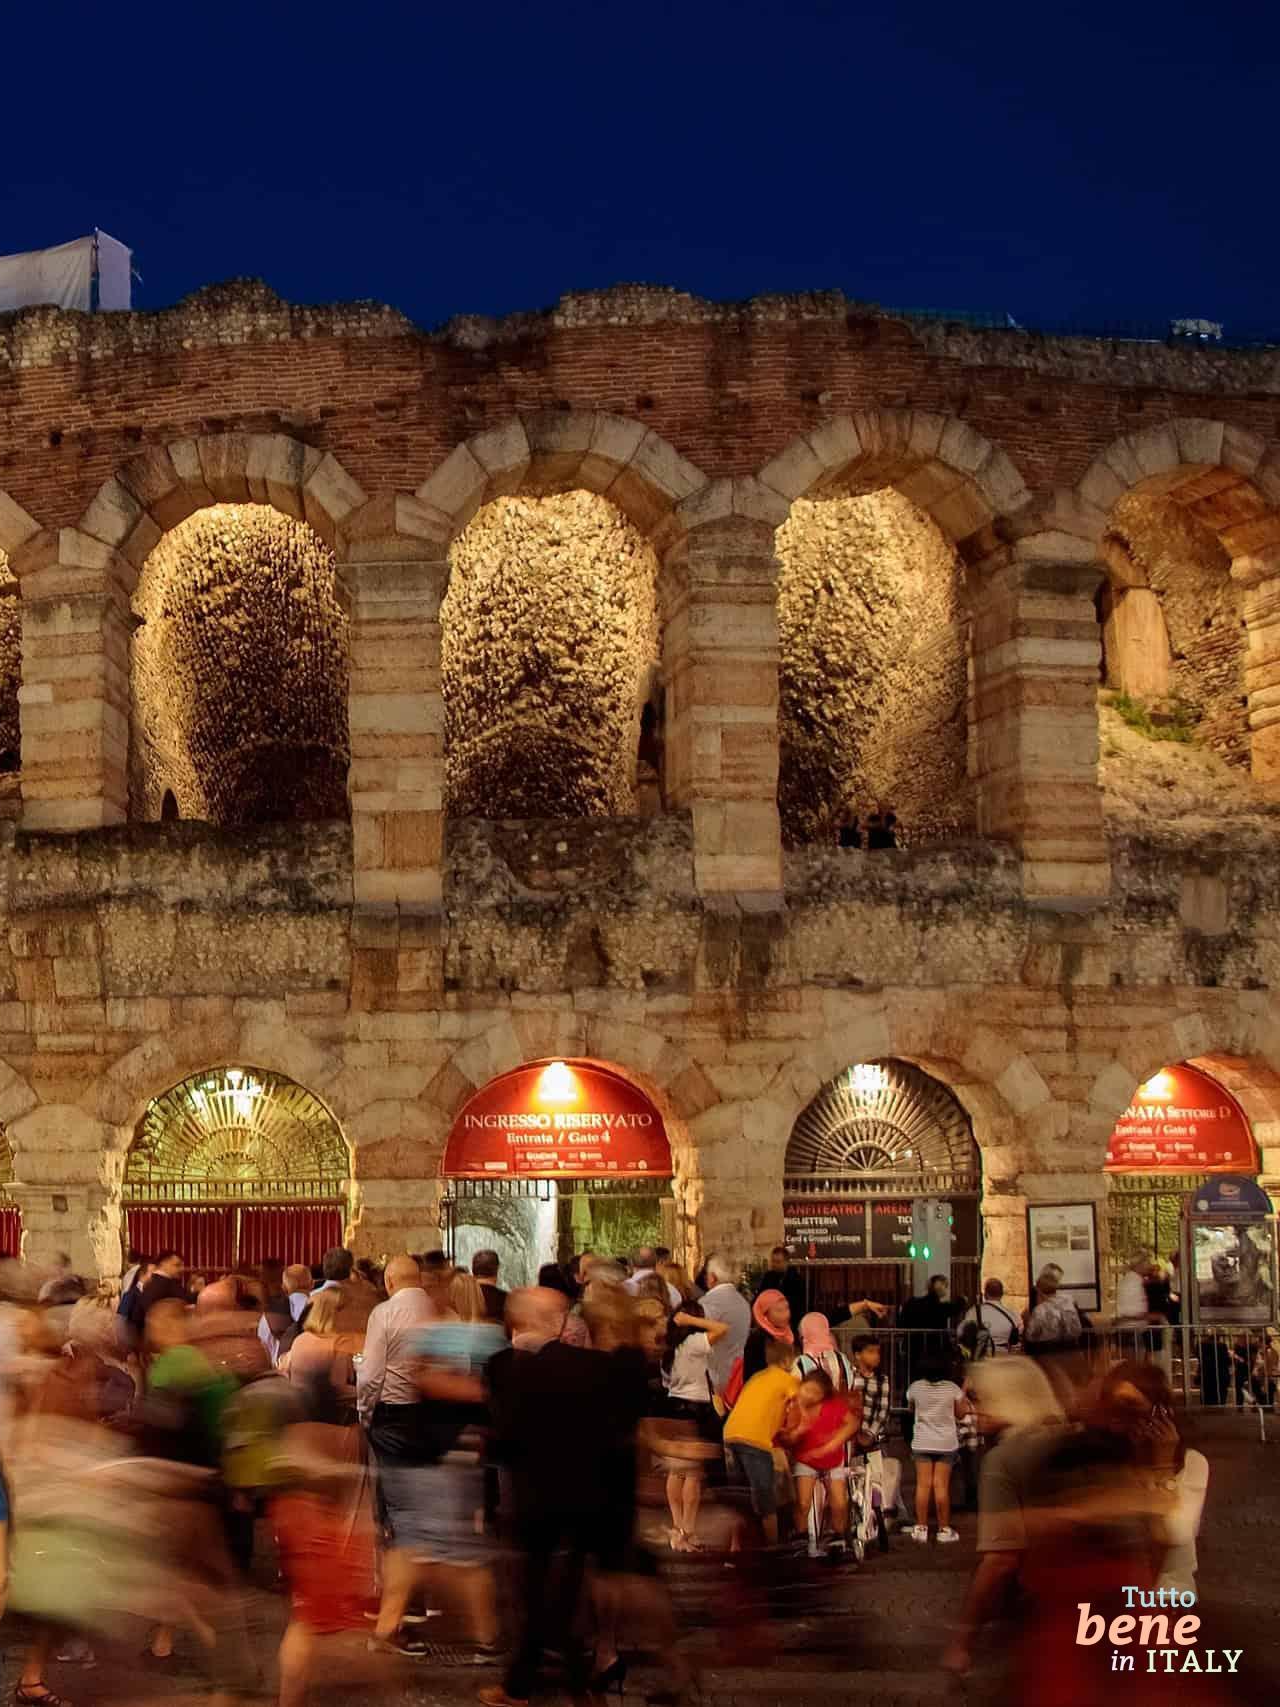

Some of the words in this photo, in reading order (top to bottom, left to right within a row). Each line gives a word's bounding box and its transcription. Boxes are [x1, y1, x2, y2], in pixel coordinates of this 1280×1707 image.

[1120, 1105, 1165, 1120] NATA
[465, 1113, 550, 1128] INGRESSO
[554, 1113, 652, 1128] RISERVATO
[507, 1132, 554, 1144] Entrata
[568, 1132, 600, 1144] Gate
